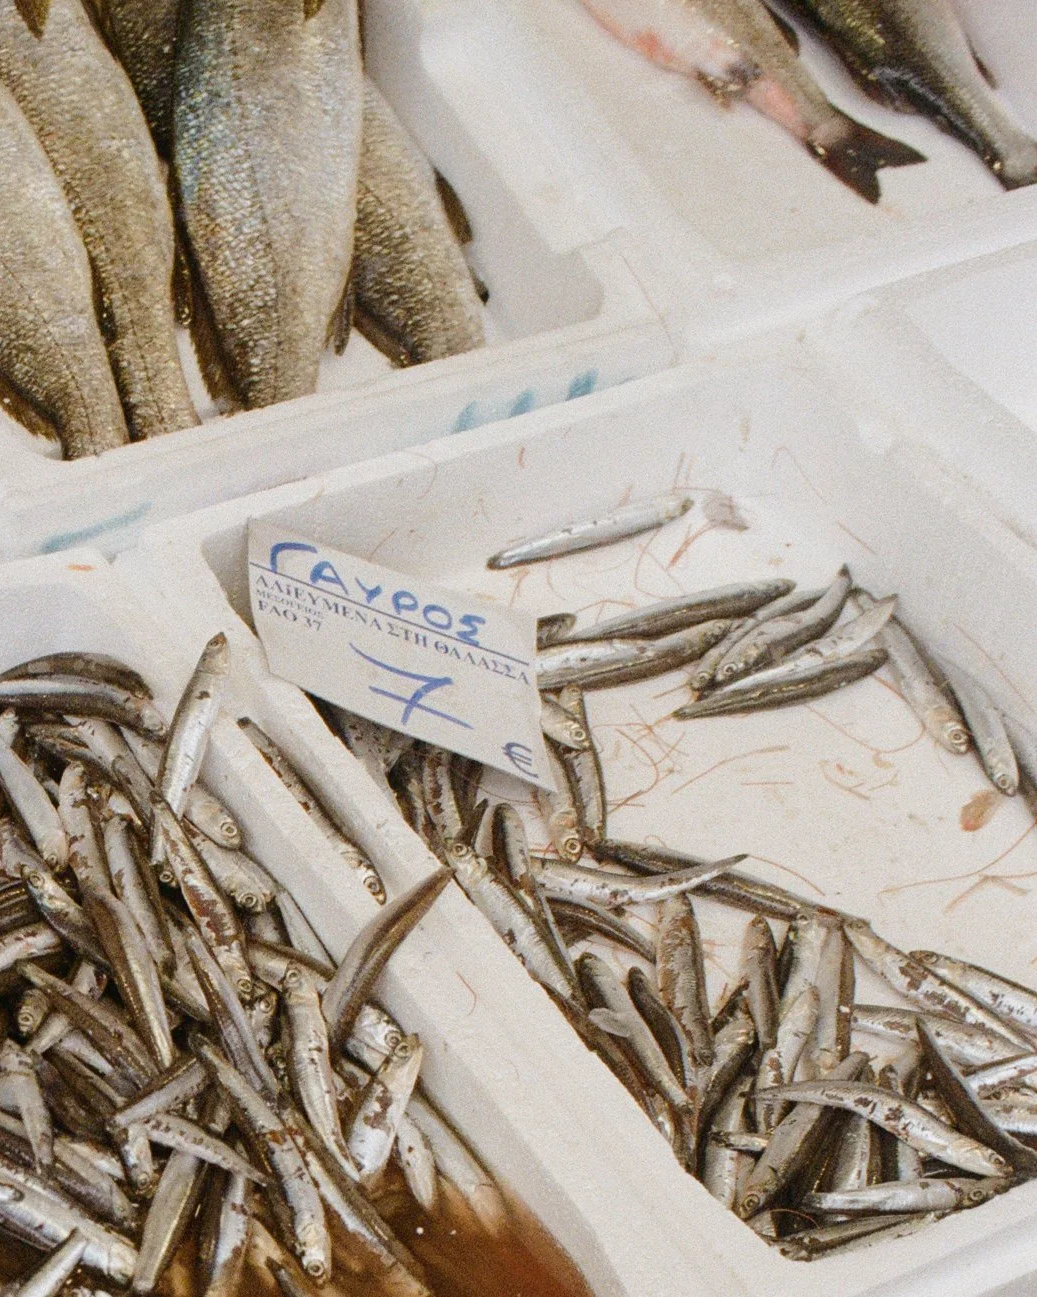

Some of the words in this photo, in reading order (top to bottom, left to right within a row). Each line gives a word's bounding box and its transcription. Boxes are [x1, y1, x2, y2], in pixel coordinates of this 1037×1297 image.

[270, 541, 486, 647] ΓΑΥΡΟΣ
[304, 616, 323, 631] 37
[386, 619, 429, 649] ΣΤΗ
[433, 640, 530, 685] ΘΑΛΑΣΣΑ
[349, 642, 474, 730] 7
[502, 742, 539, 778] €
